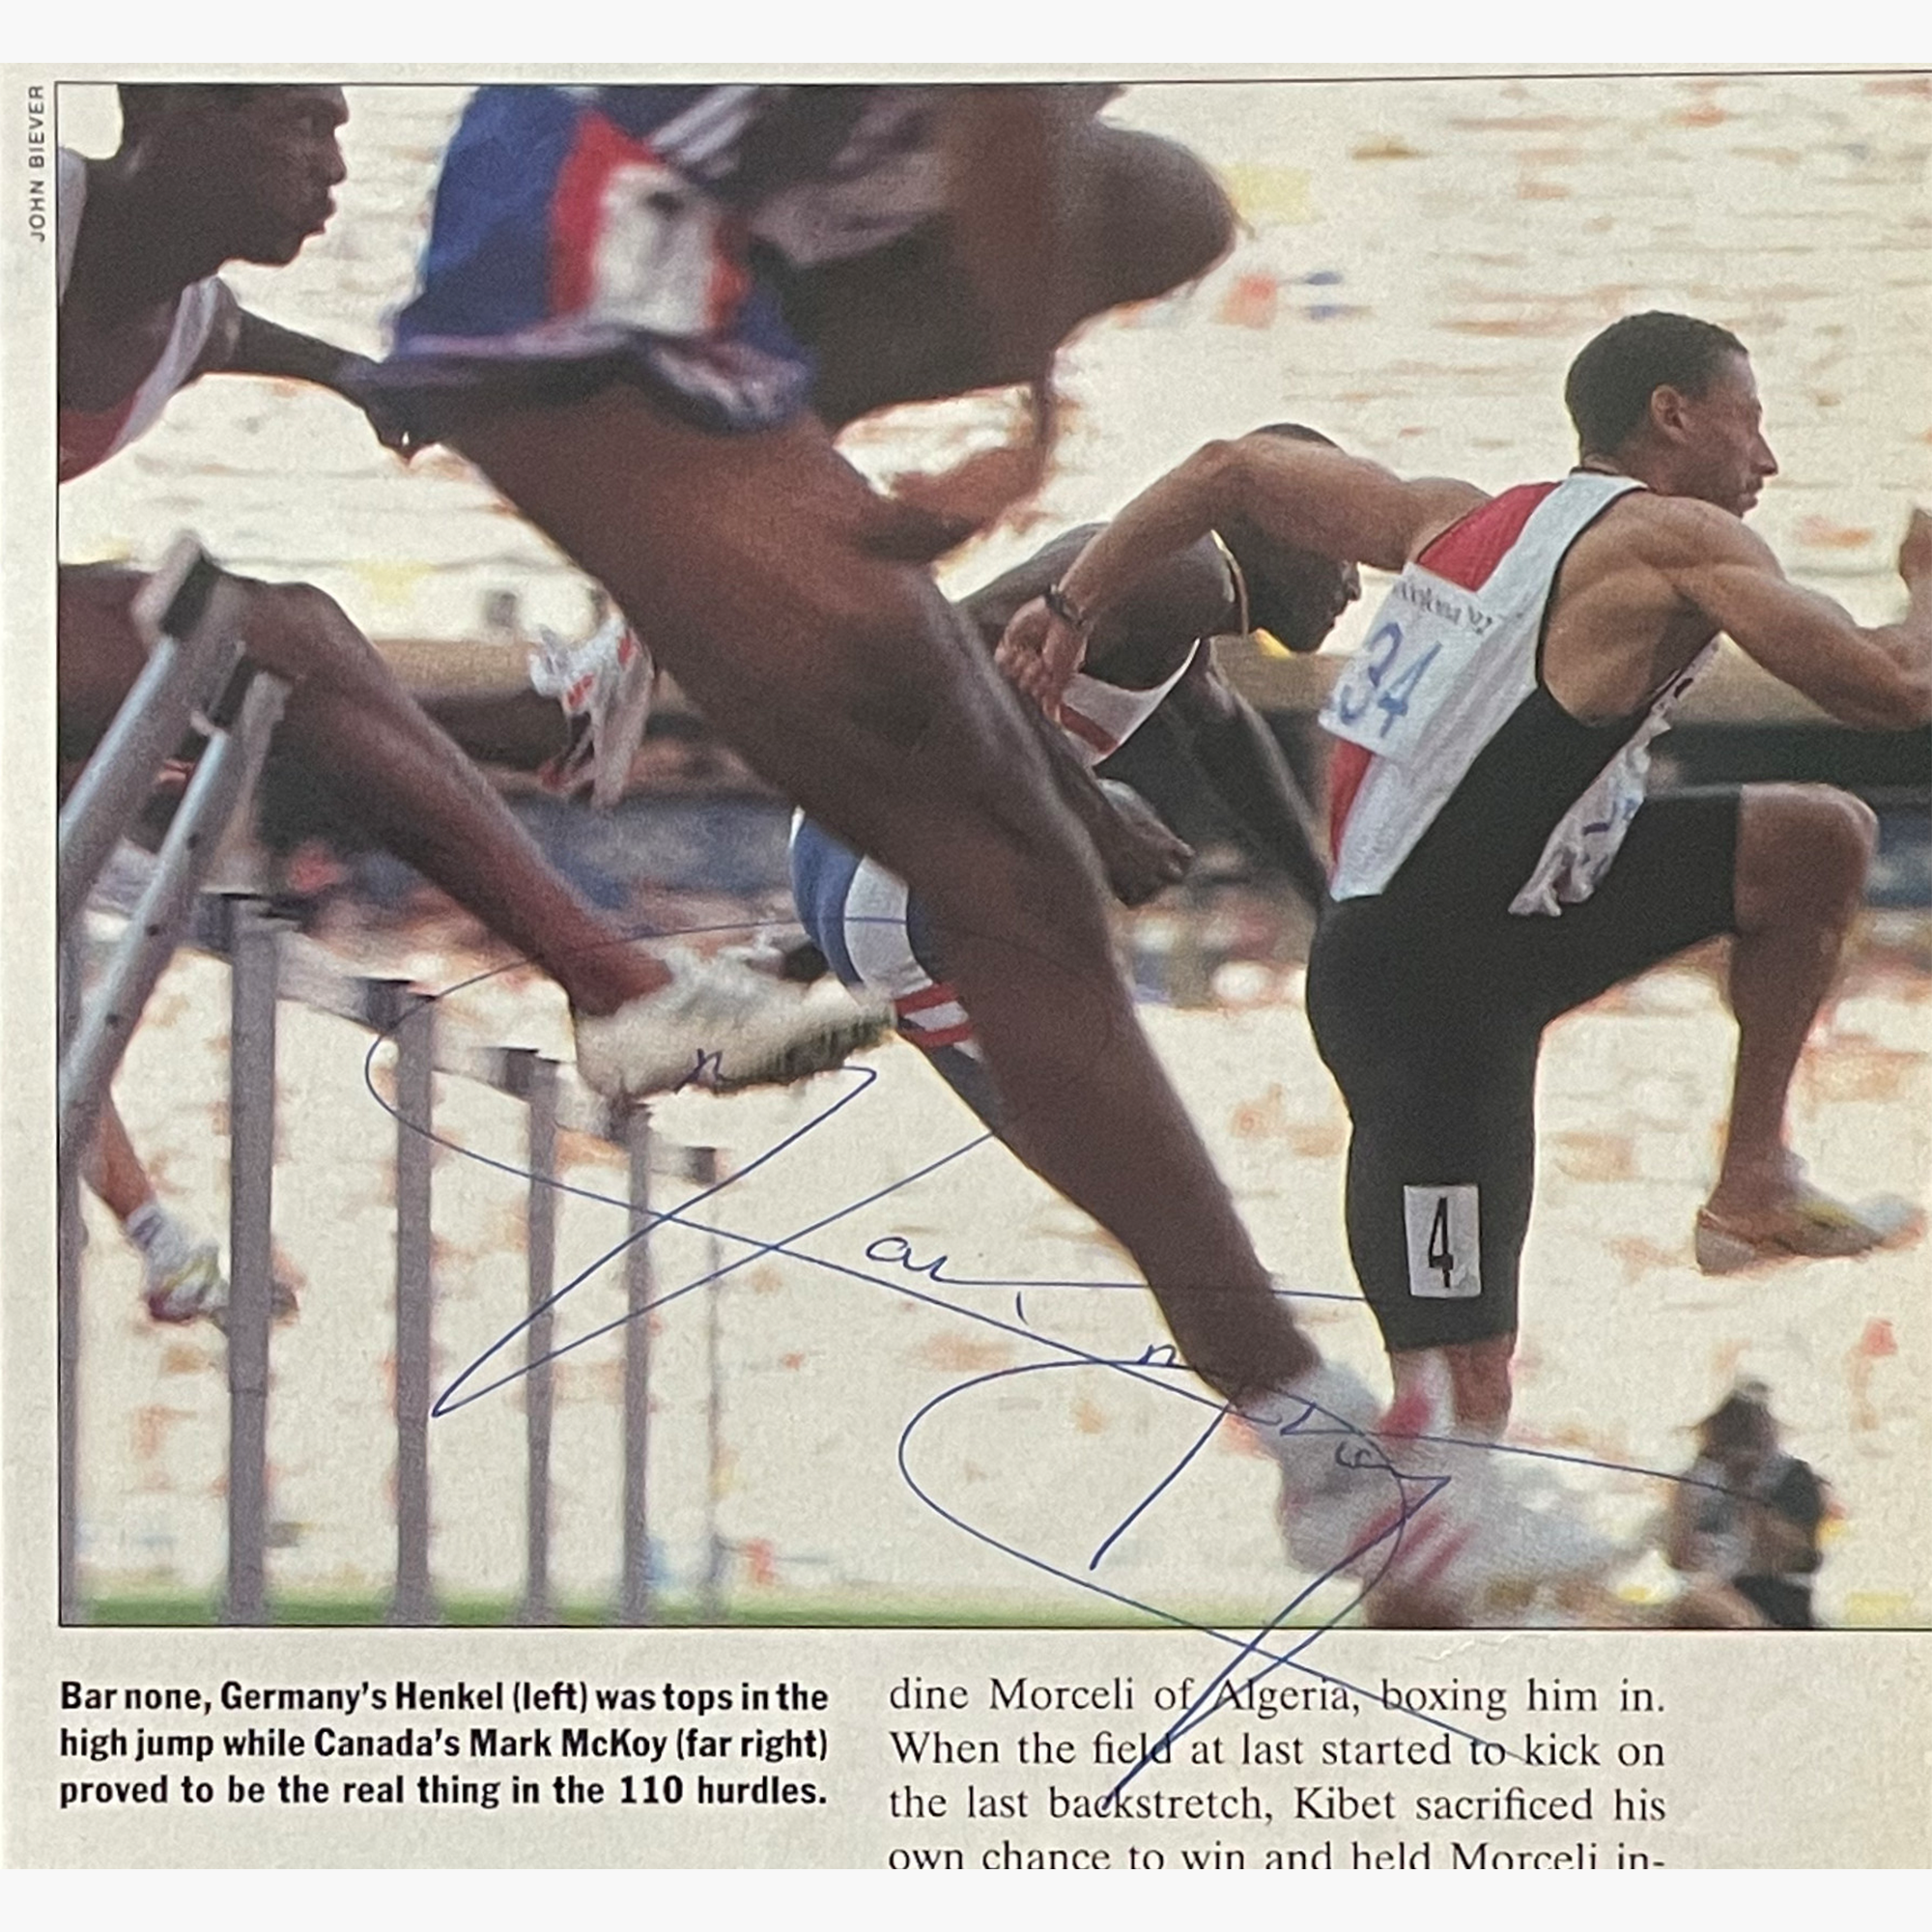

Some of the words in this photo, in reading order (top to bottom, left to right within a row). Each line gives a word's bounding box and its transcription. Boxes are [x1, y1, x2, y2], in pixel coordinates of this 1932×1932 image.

[28, 86, 44, 168] BIEVER
[29, 181, 45, 242] JOHN
[1428, 1197, 1454, 1289] 4
[61, 1681, 118, 1710] Bar
[125, 1689, 212, 1716] none,
[220, 1681, 387, 1716] Germany's
[396, 1681, 503, 1710] Henkel
[513, 1681, 587, 1714] (left)
[596, 1690, 656, 1710] was
[663, 1683, 733, 1717] tops
[742, 1682, 769, 1711] in
[776, 1682, 828, 1711] the
[890, 1677, 968, 1710] dine
[990, 1677, 1133, 1710] Morceli
[1154, 1676, 1193, 1710] of
[1215, 1677, 1360, 1719] Algeria,
[1381, 1678, 1508, 1719] boxing
[1528, 1678, 1597, 1711] him
[1621, 1679, 1665, 1712] in.
[61, 1727, 128, 1762] high
[134, 1727, 213, 1762] jump
[223, 1727, 305, 1757] while
[314, 1727, 460, 1757] Canada's
[470, 1728, 552, 1757] Mark
[561, 1728, 668, 1763] McKoy
[676, 1727, 732, 1761] (far
[741, 1728, 828, 1763] right)
[890, 1731, 999, 1764] When
[1018, 1731, 1075, 1764] the
[1094, 1730, 1172, 1764] field
[1190, 1738, 1224, 1765] at
[1242, 1732, 1302, 1765] last
[1321, 1731, 1451, 1766] started
[1469, 1738, 1507, 1766] to
[1525, 1732, 1601, 1766] kick
[1618, 1744, 1664, 1767] on
[60, 1775, 168, 1809] proved
[181, 1776, 213, 1804] to
[228, 1775, 265, 1804] be
[277, 1775, 329, 1804] the
[343, 1775, 404, 1804] real
[416, 1775, 501, 1809] thing
[512, 1775, 539, 1804] in
[553, 1775, 605, 1804] the
[621, 1775, 683, 1804] 110
[697, 1775, 827, 1804] hurdles.
[890, 1785, 948, 1818] the
[968, 1785, 1028, 1818] last
[1049, 1785, 1273, 1825] backstretch,
[1294, 1786, 1396, 1820] Kibet
[1415, 1787, 1593, 1821] sacrificed
[1615, 1788, 1666, 1821] his
[889, 1849, 963, 1869] own
[982, 1840, 1110, 1869] chance
[1129, 1846, 1164, 1869] to
[1181, 1840, 1244, 1869] win
[1265, 1840, 1332, 1869] and
[1352, 1841, 1430, 1869] held
[1452, 1842, 1598, 1869] Morceli
[1617, 1843, 1665, 1869] in-
